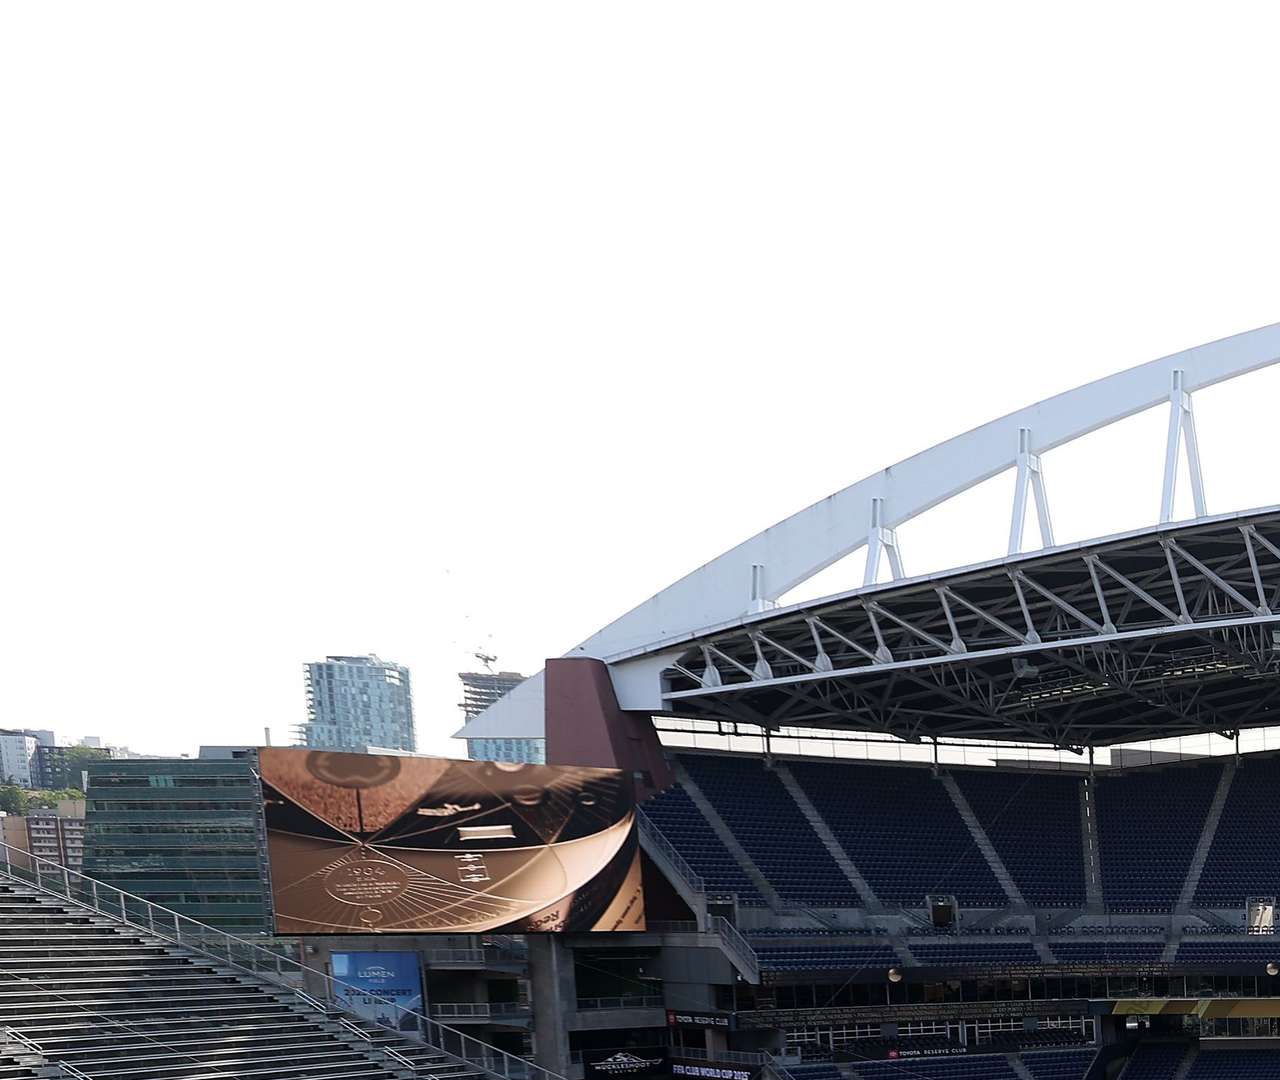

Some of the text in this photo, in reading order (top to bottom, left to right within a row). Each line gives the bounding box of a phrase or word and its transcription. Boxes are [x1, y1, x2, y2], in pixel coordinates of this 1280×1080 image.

[673, 1064, 684, 1075] FIFA
[686, 1066, 699, 1076] CLUB
[700, 1068, 720, 1079] WORLD
[721, 1070, 733, 1080] CUP
